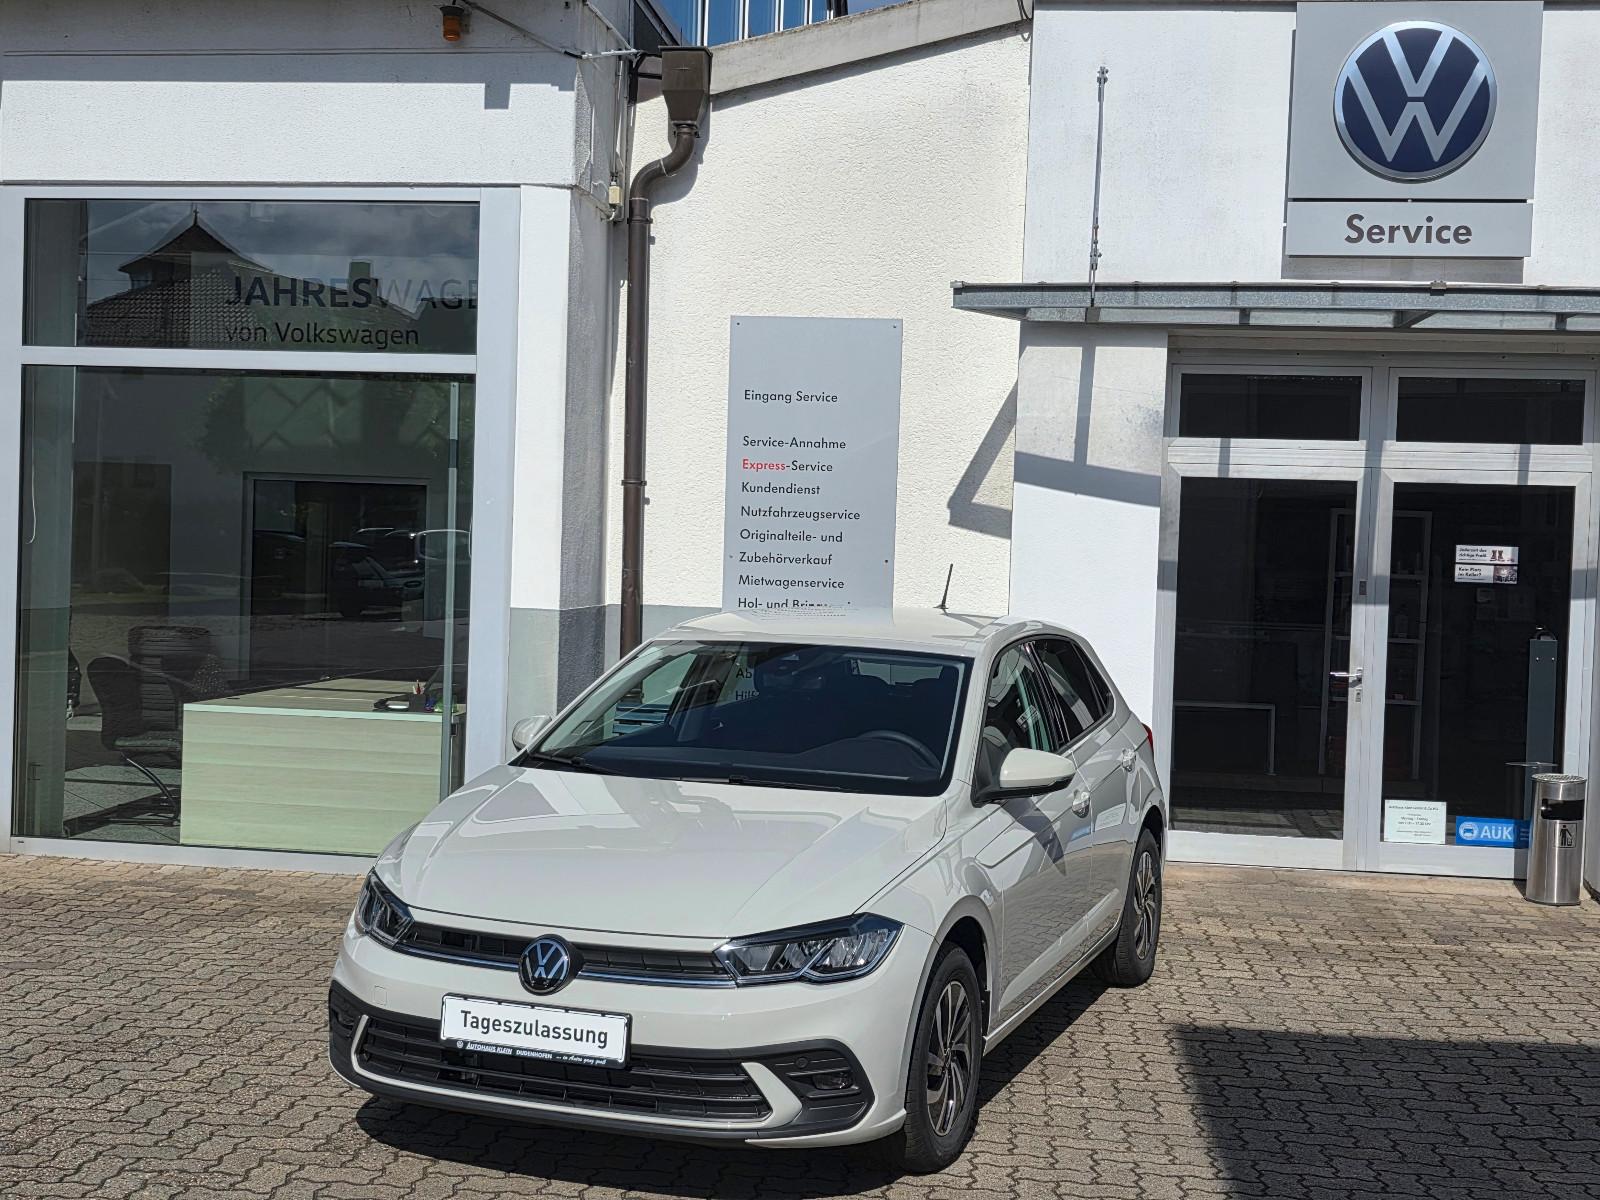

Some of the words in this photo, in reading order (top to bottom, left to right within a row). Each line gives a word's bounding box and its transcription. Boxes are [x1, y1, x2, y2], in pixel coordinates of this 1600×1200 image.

[1340, 23, 1492, 170] VW
[1344, 213, 1473, 244] Service
[225, 325, 267, 342] von
[275, 322, 419, 349] Volkswagen
[744, 389, 792, 404] Eingang
[795, 390, 838, 402] Service
[743, 435, 846, 449] Service-Annahme
[742, 458, 833, 472] Express-Service
[741, 481, 821, 494] Kundendienst
[740, 505, 861, 521] Nutzfahrzeugservice
[739, 528, 817, 542] Originalteile-
[820, 531, 843, 542] und
[739, 551, 833, 565] Zubehörverkauf
[738, 574, 845, 589] Mietwagenservice
[738, 597, 763, 608] Hol-
[766, 598, 788, 608] und
[461, 1010, 608, 1049] Tageszulassung
[466, 1041, 496, 1053] AUTOHAUS
[497, 1046, 513, 1055] KLEIN
[516, 1049, 553, 1060] DUDENHOFEN
